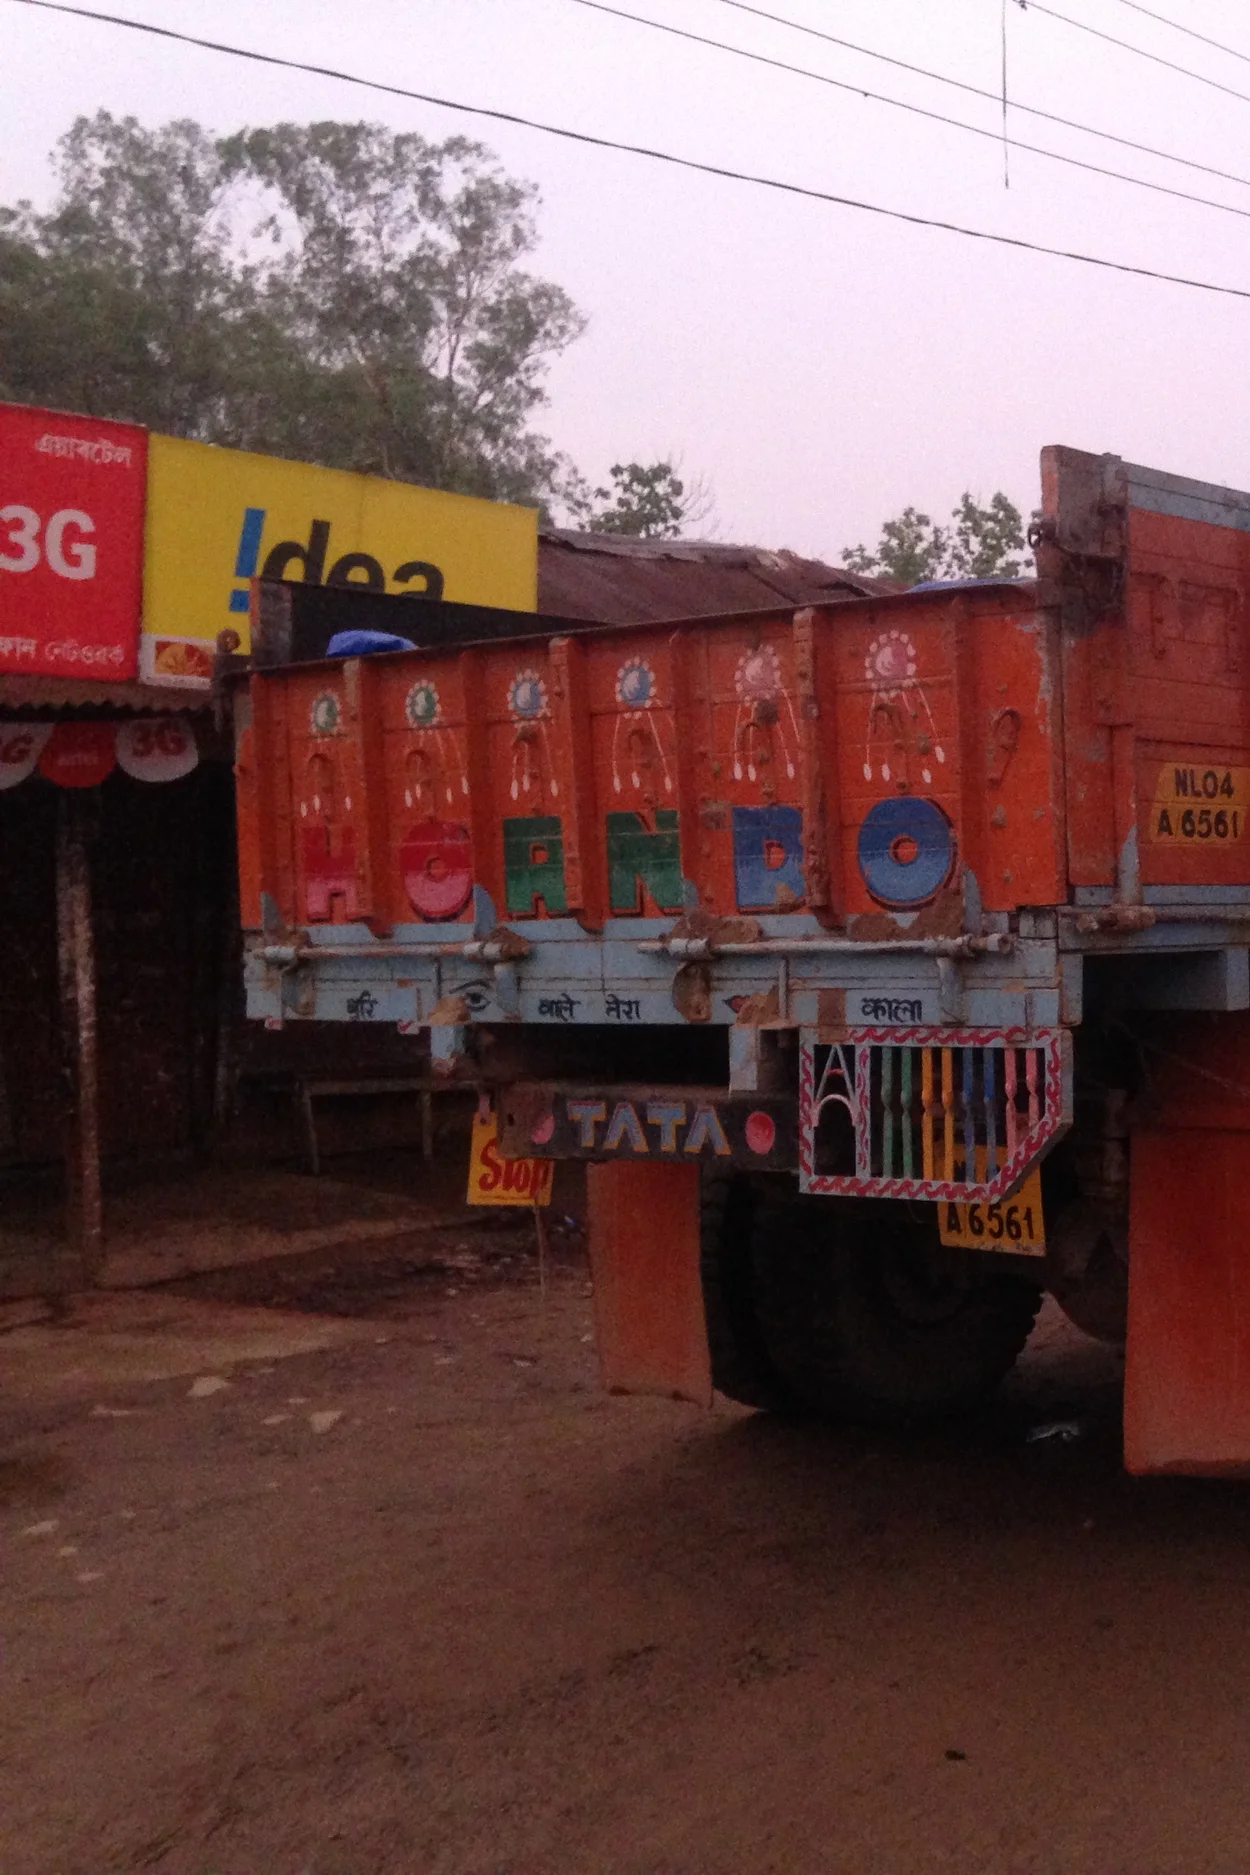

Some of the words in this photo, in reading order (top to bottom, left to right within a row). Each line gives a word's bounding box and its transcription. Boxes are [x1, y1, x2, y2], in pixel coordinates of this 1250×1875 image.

[0, 504, 97, 581] 3G
[1174, 767, 1235, 799] NL04
[1157, 808, 1174, 837] A
[1181, 808, 1239, 839] 6561
[301, 809, 684, 923] HORN
[861, 997, 923, 1022] काला
[567, 1100, 733, 1156] TATA
[946, 1201, 962, 1234] A
[968, 1203, 1034, 1240] 6561
